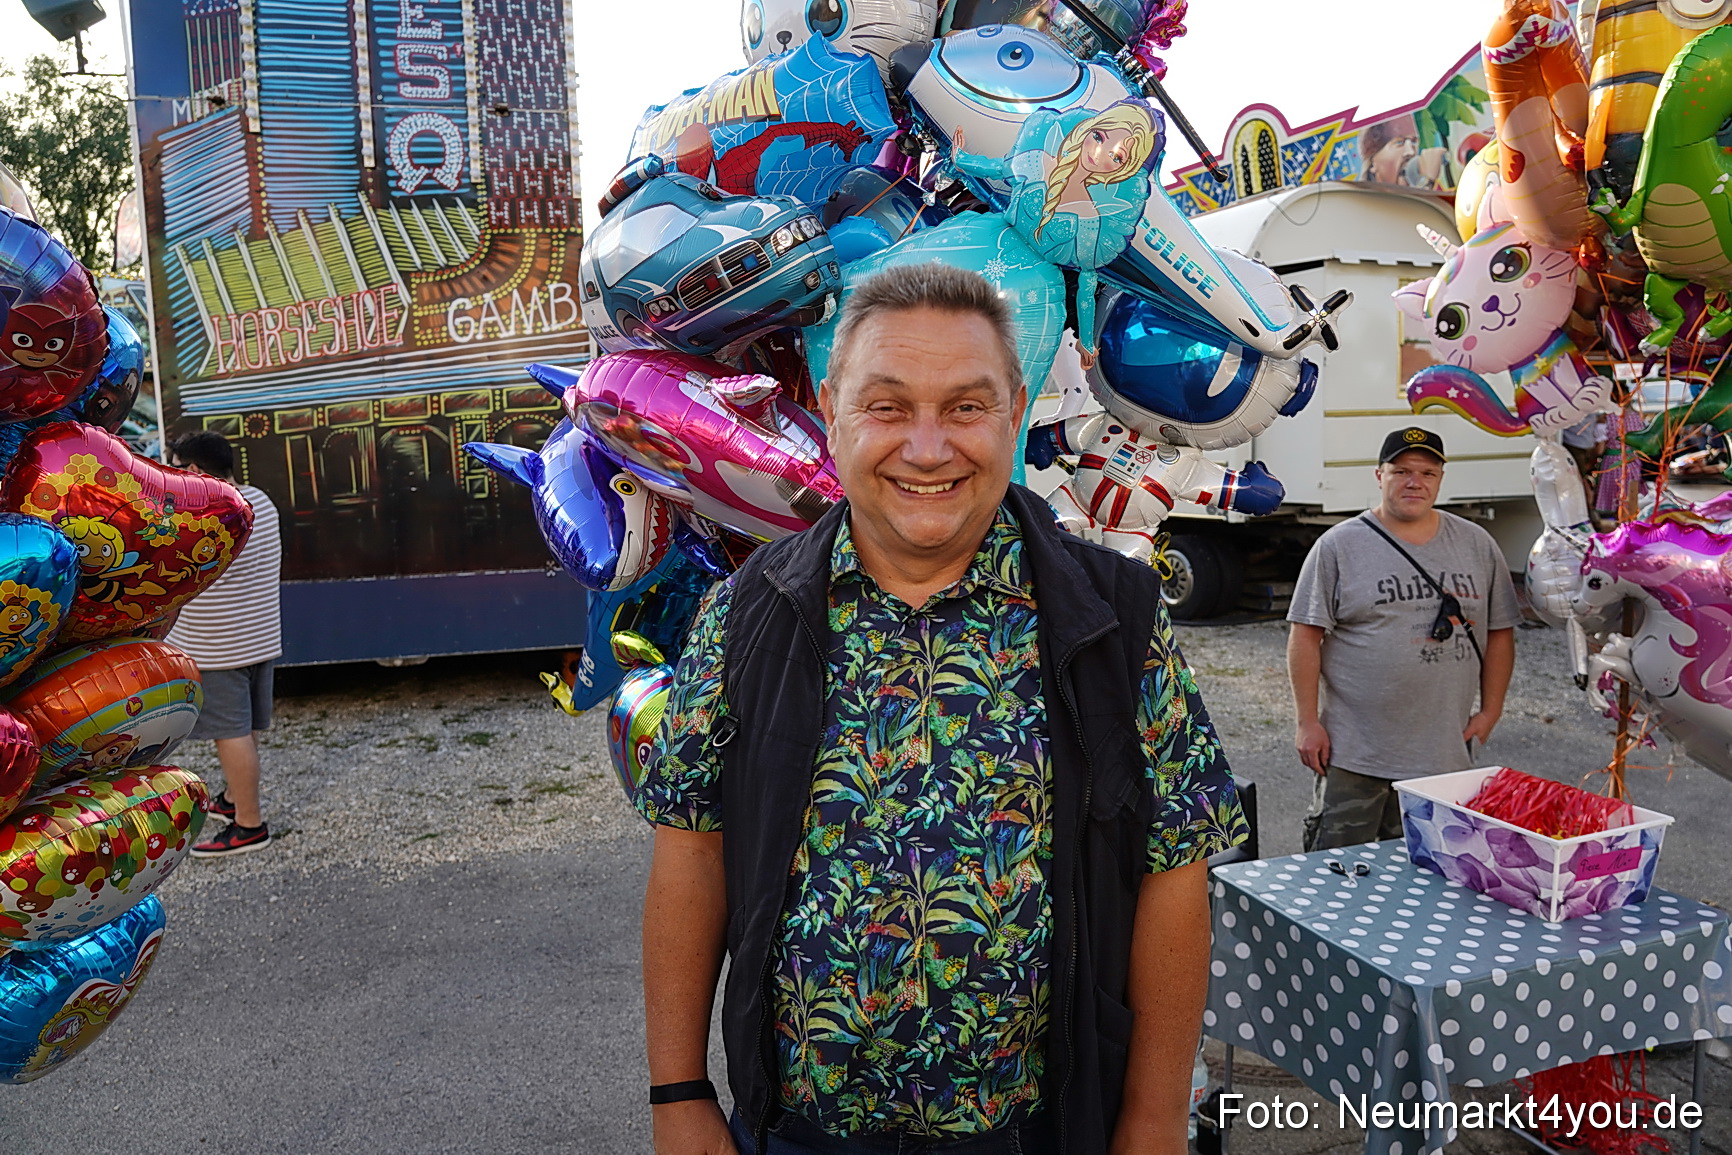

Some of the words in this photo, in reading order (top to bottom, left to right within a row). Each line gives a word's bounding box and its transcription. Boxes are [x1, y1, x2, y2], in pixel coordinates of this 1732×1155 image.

[211, 283, 404, 375] HORSESHOE
[447, 282, 586, 343] GAMB
[578, 647, 595, 688] 8-18
